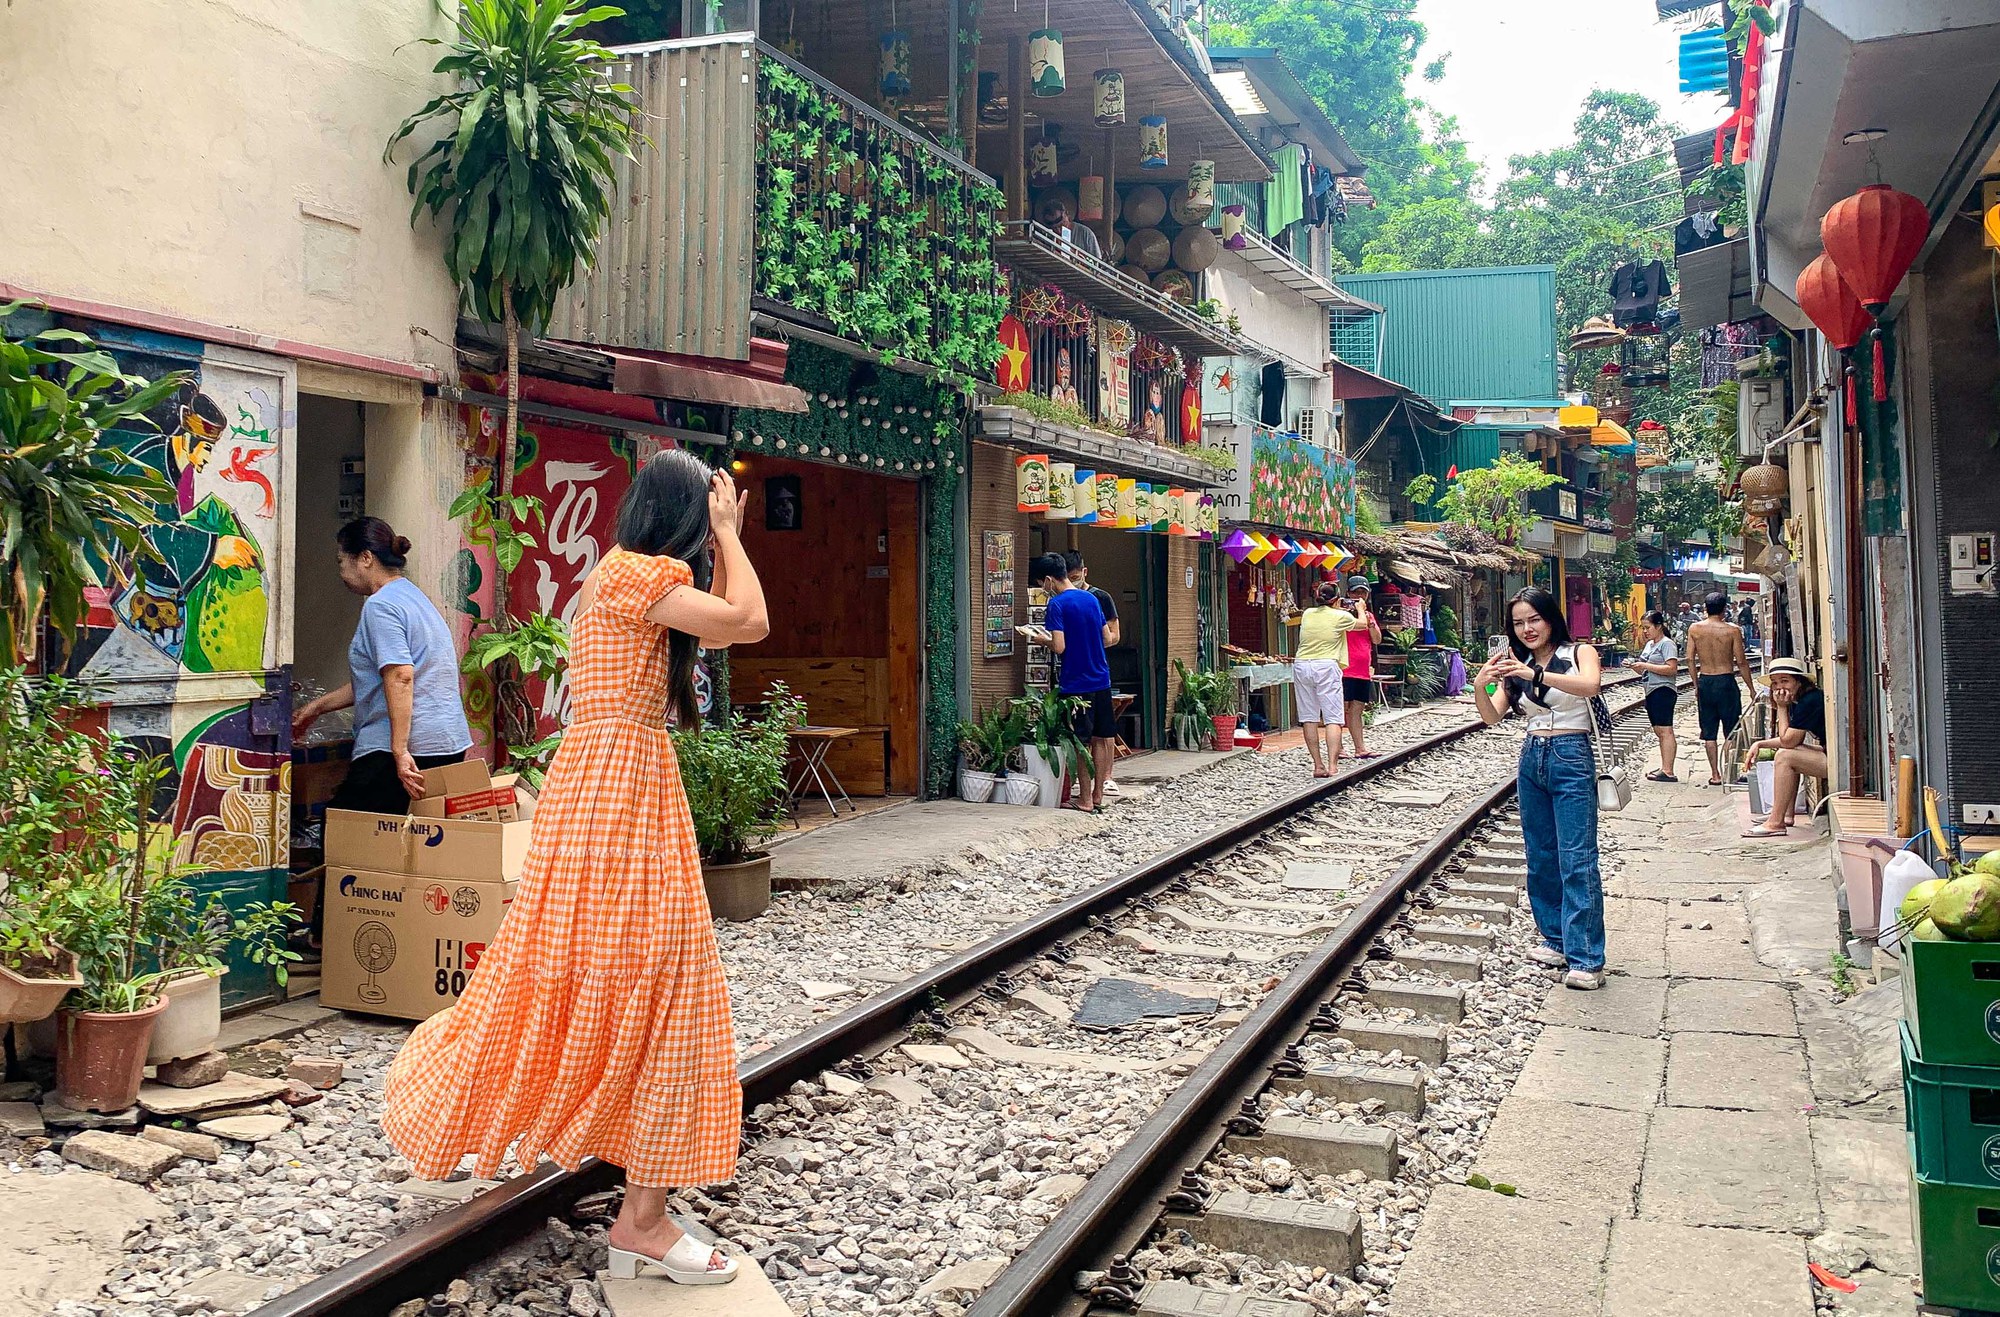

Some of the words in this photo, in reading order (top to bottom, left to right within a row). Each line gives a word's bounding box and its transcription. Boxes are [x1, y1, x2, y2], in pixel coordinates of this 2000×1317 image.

[377, 820, 398, 832] HAI
[339, 874, 379, 899] CHING
[382, 890, 402, 902] HAI
[357, 907, 381, 916] STAND
[434, 968, 475, 998] 80
